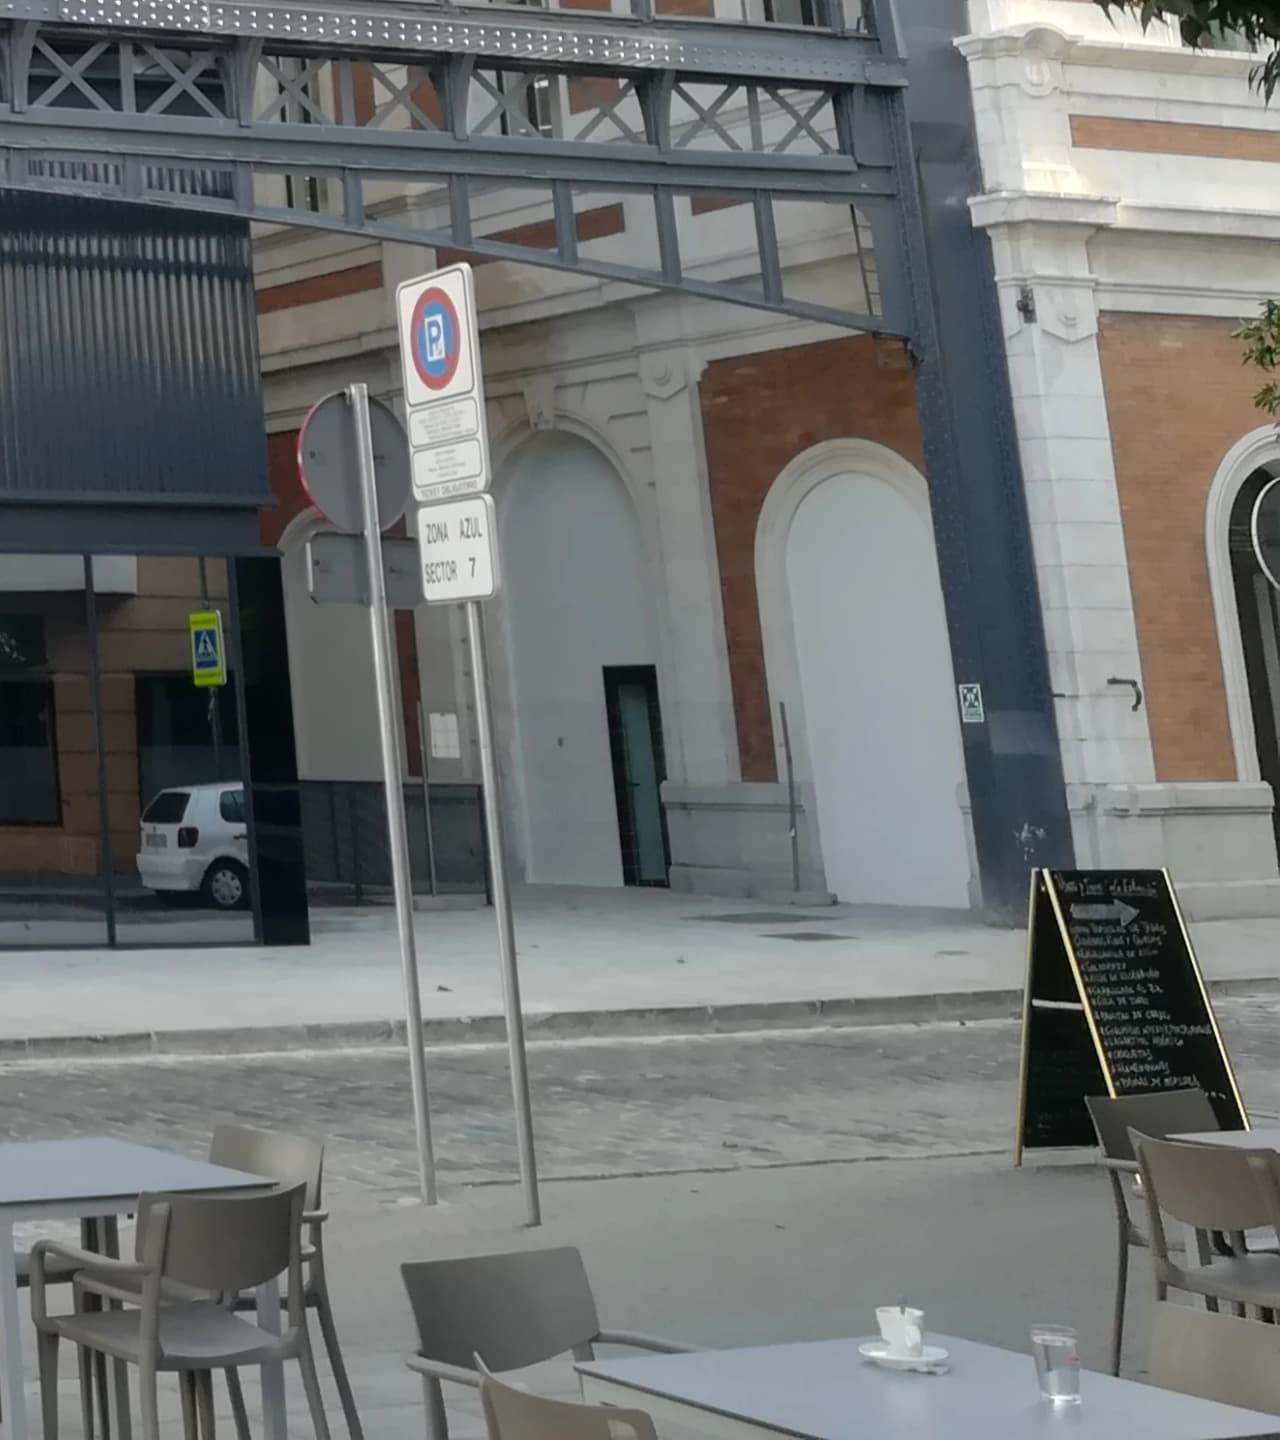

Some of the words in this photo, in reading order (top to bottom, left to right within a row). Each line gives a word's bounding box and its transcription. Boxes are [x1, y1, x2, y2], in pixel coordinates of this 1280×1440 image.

[426, 522, 450, 544] ZONA
[459, 517, 483, 540] AZUL
[425, 559, 458, 584] SECTOR
[468, 556, 477, 578] 7
